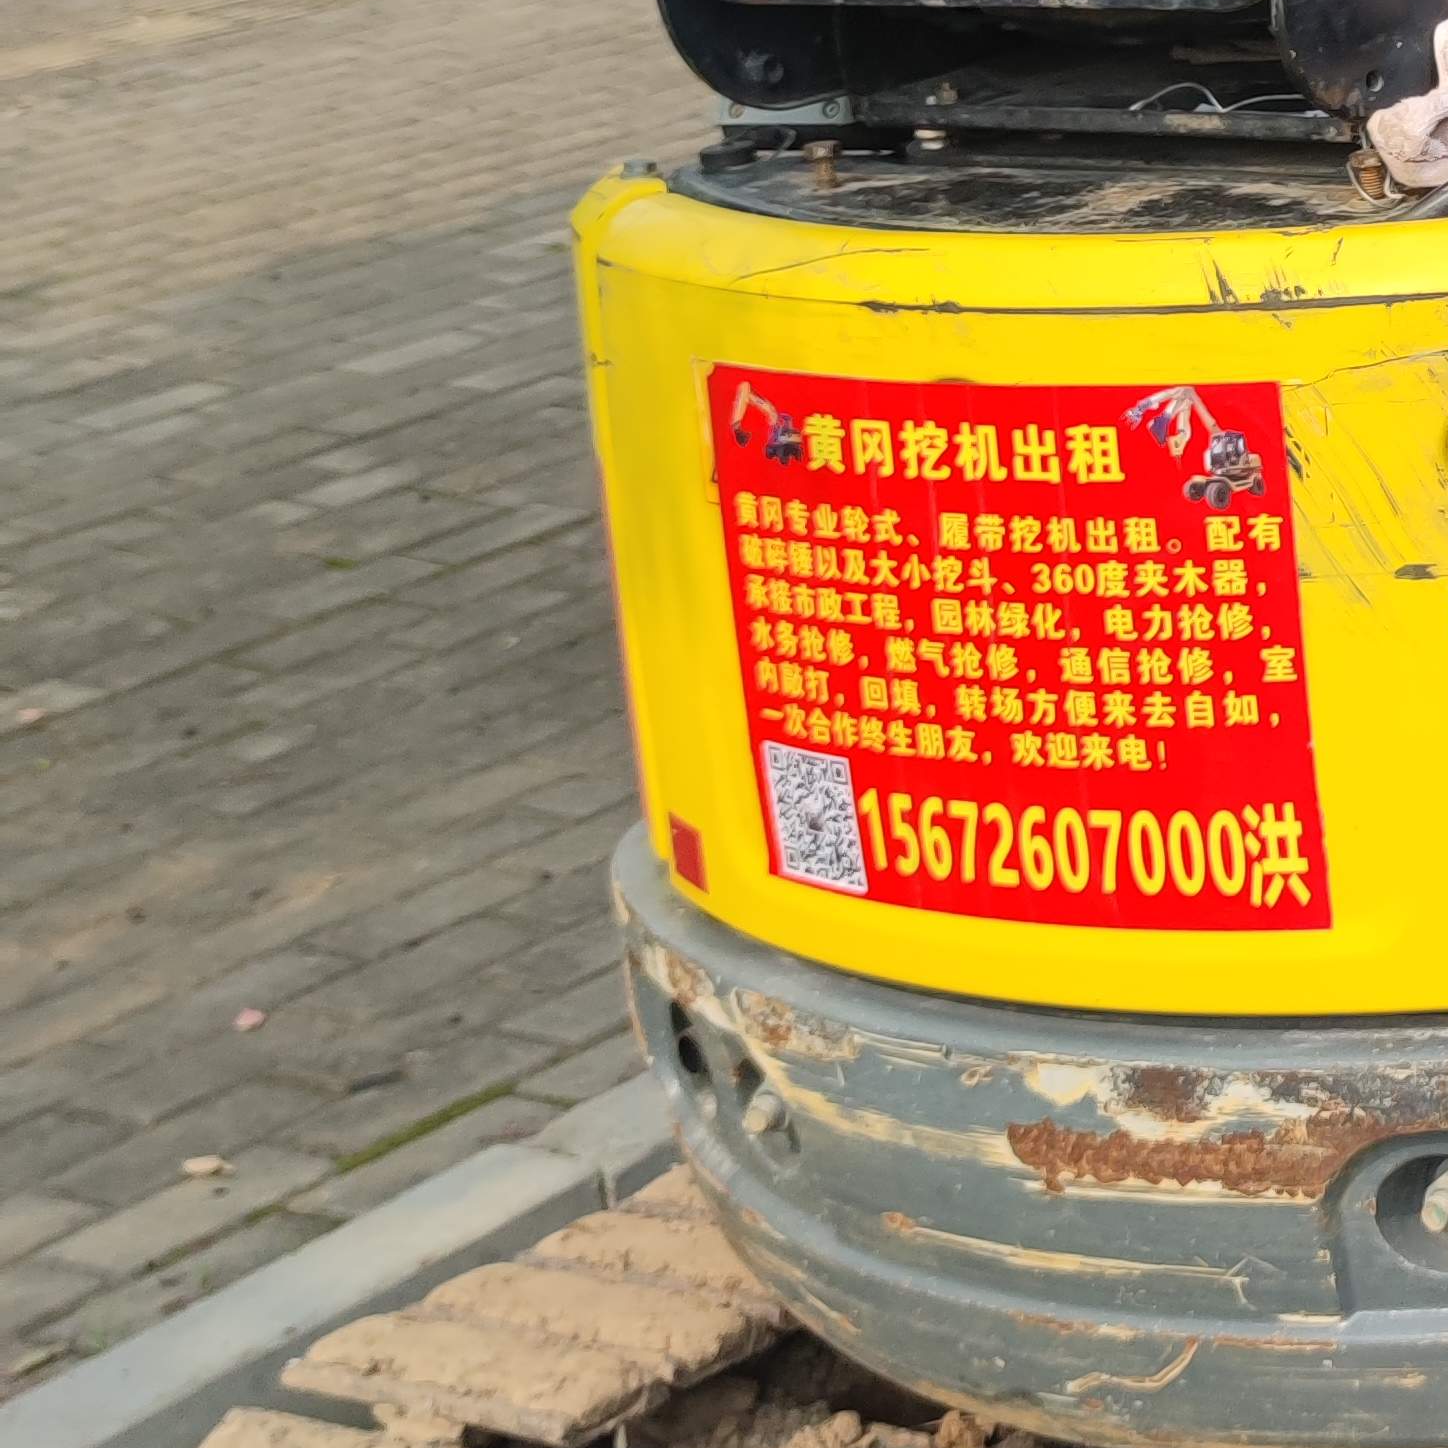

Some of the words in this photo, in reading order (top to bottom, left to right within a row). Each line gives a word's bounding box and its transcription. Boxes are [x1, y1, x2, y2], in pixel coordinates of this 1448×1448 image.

[803, 412, 1126, 485] 黄冈挖机出租
[859, 787, 1312, 908] 15672607000洪
